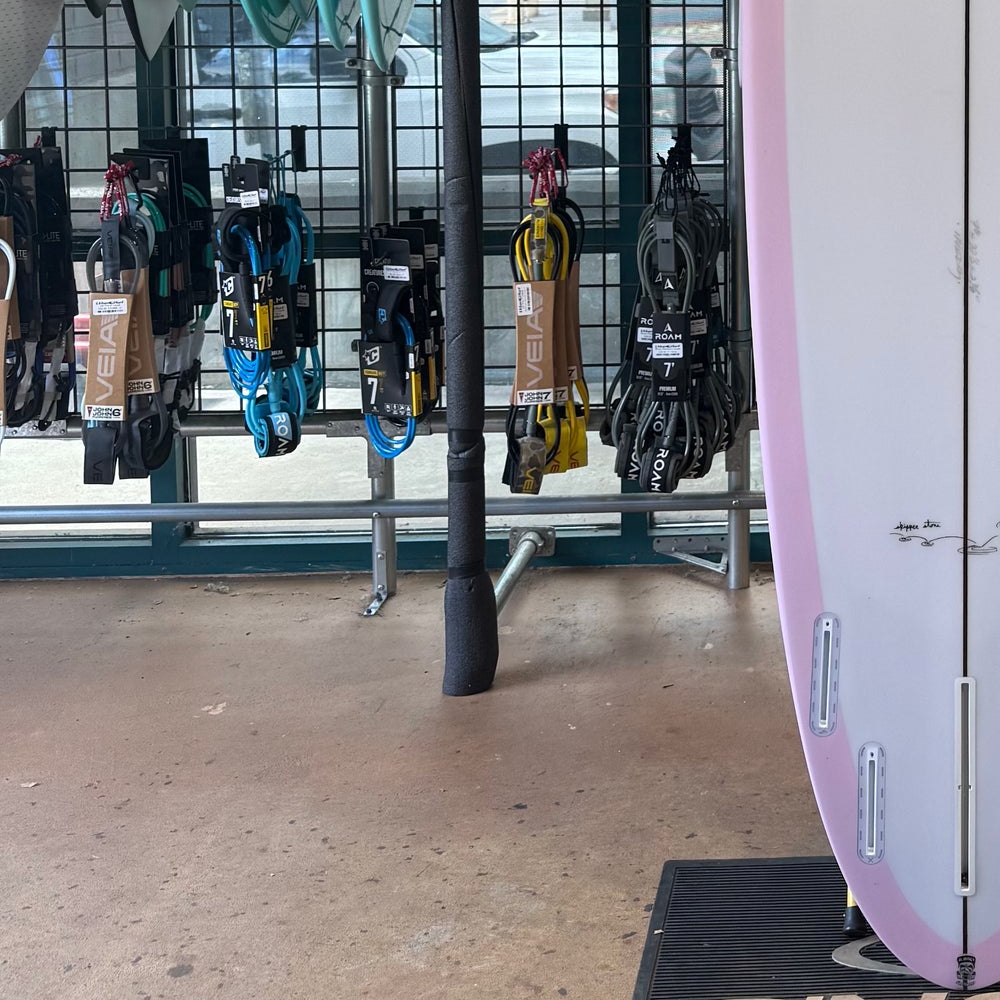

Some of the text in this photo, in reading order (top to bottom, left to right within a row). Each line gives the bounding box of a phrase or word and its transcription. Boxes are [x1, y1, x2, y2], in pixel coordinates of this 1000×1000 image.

[95, 319, 119, 403] VEIA
[526, 306, 544, 389] VEIA
[651, 448, 669, 491] ROAM
